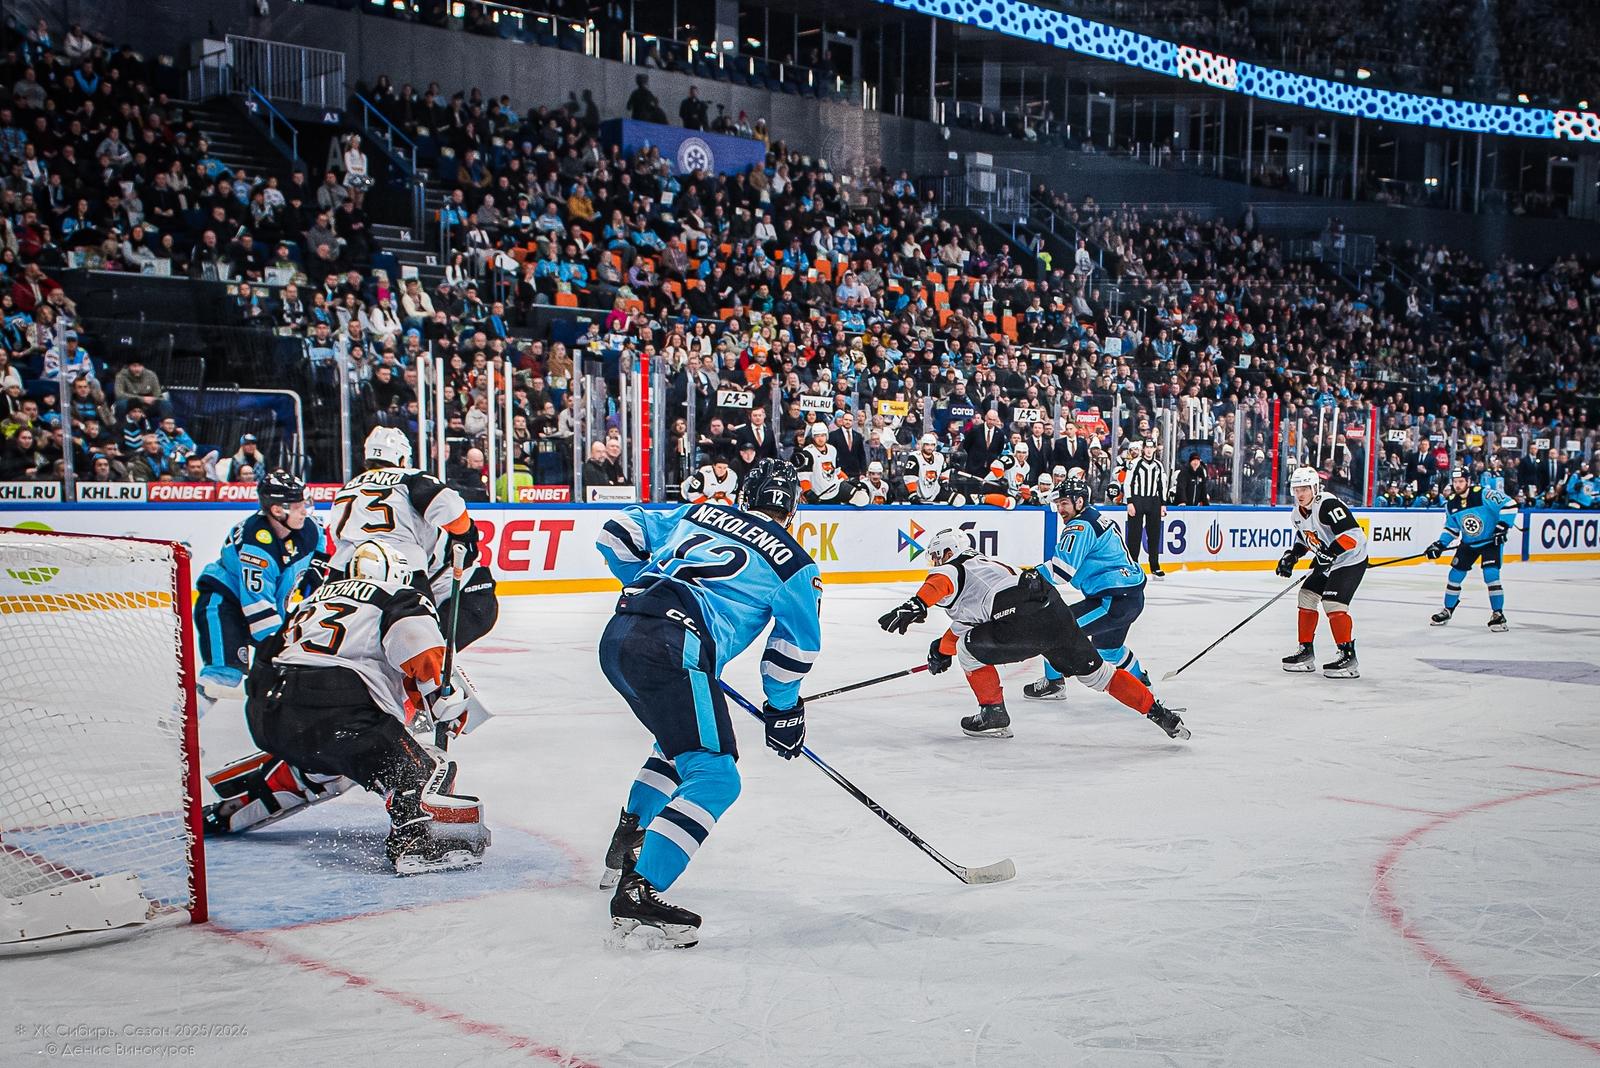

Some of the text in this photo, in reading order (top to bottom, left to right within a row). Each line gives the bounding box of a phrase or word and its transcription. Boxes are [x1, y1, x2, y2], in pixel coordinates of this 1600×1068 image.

[802, 399, 831, 409] KHL.RU
[373, 448, 382, 457] 73
[81, 486, 142, 499] KHL.RU
[151, 485, 214, 500] FONBET
[519, 488, 569, 501] FONBET
[772, 490, 784, 504] 12
[1327, 507, 1347, 524] 10
[691, 504, 793, 566] NEKOLENKO
[1229, 528, 1293, 548] ТЕХНОП
[1373, 527, 1412, 542] БАНК
[1541, 518, 1599, 549] сога
[474, 520, 575, 571] BET
[657, 532, 750, 585] 12
[242, 567, 263, 593] 15
[310, 580, 378, 602] ROZHKO
[666, 608, 700, 635] CC
[866, 797, 923, 846] VAPOR
